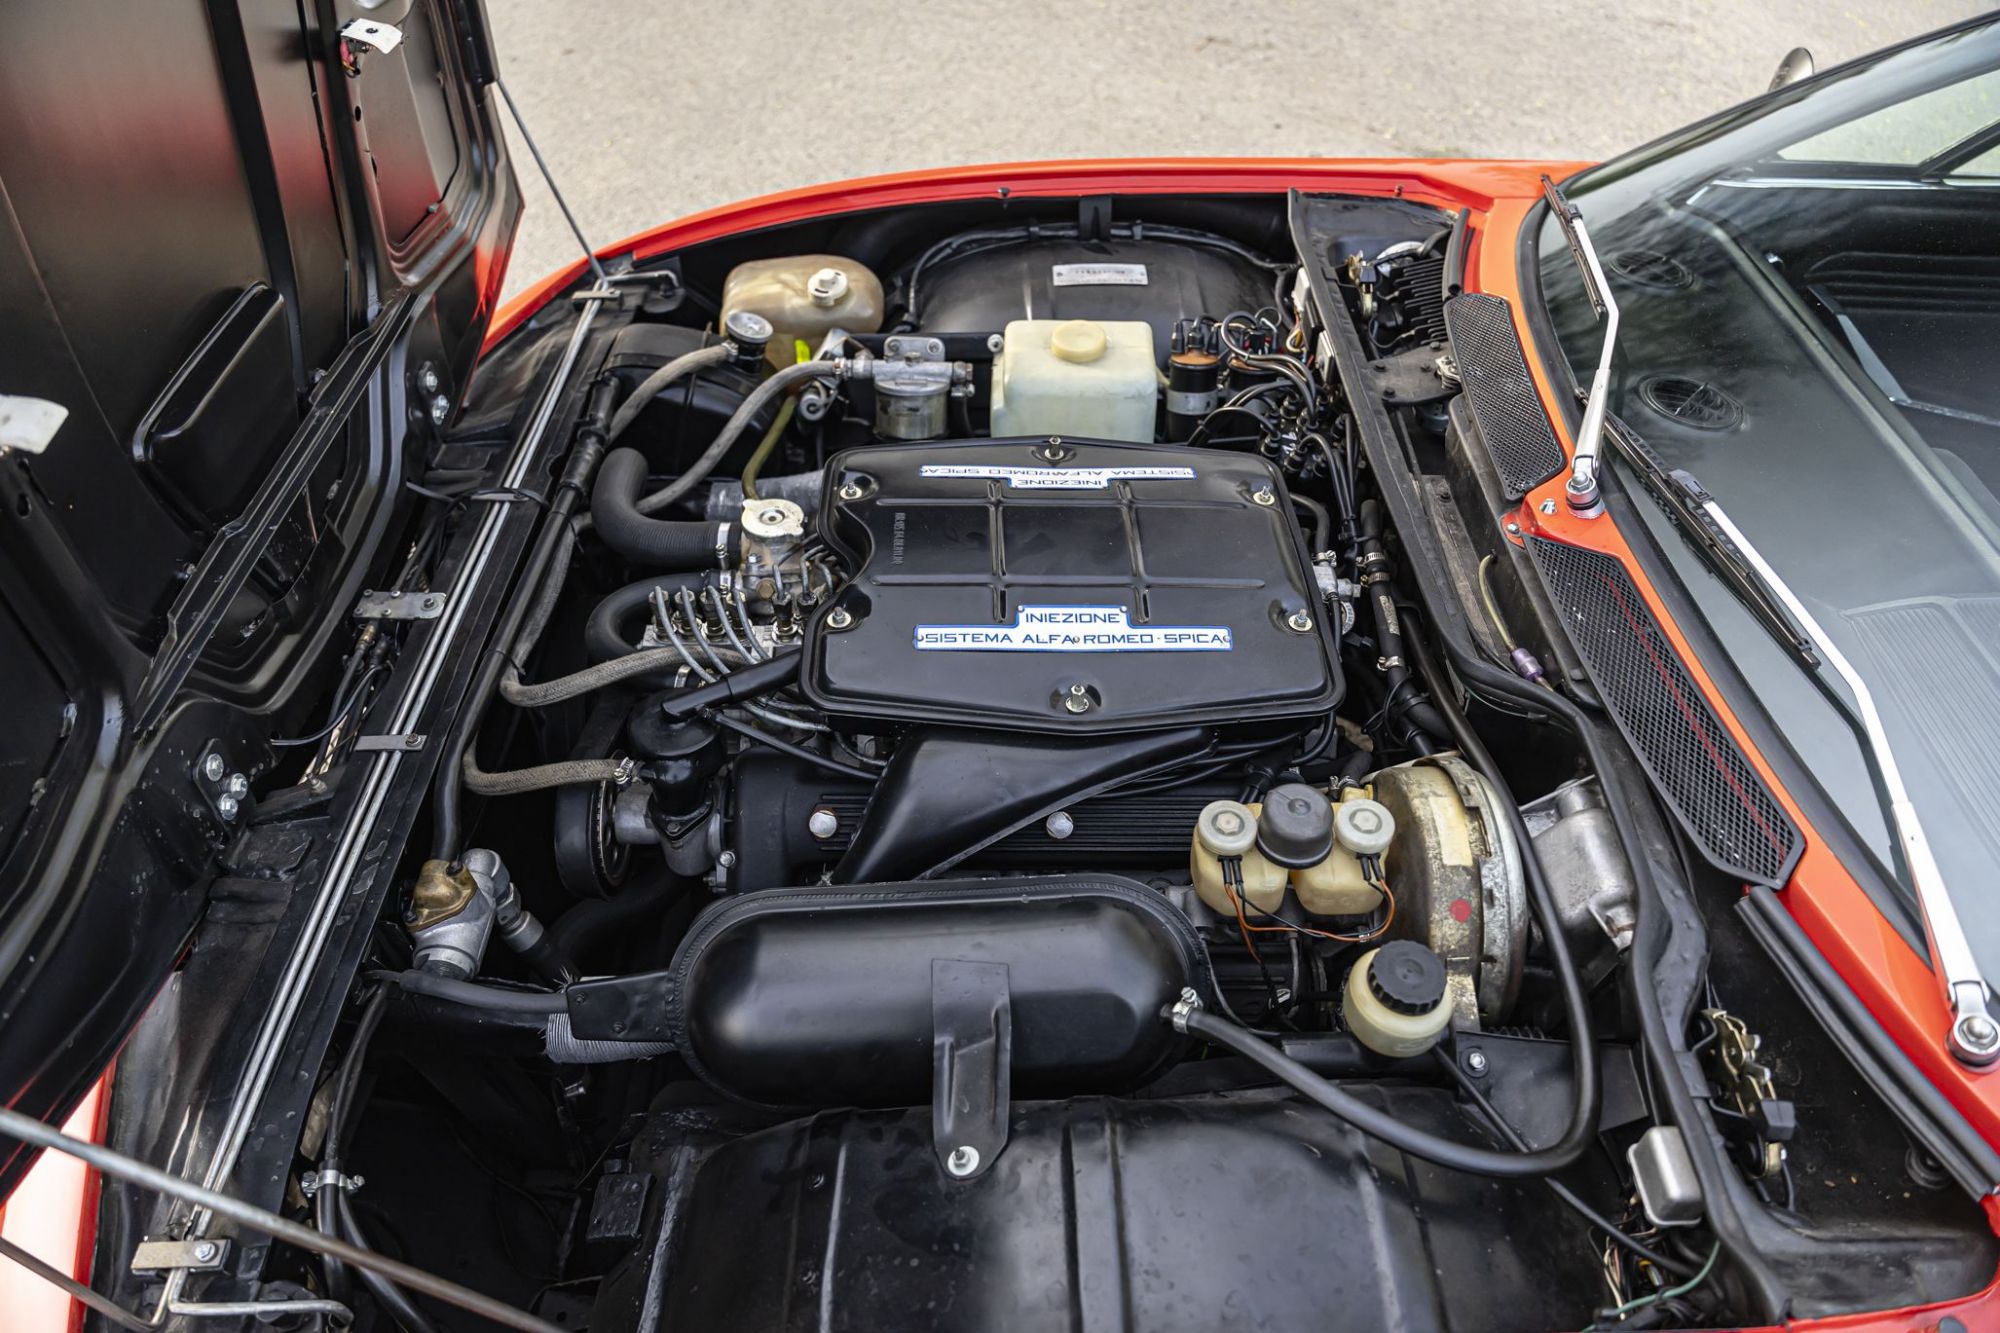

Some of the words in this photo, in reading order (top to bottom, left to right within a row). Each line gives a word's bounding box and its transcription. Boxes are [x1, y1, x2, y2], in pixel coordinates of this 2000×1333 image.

[1025, 613, 1120, 623] INIEZIONE
[925, 633, 1013, 643] SISTEMA
[1022, 634, 1074, 644] ALFA
